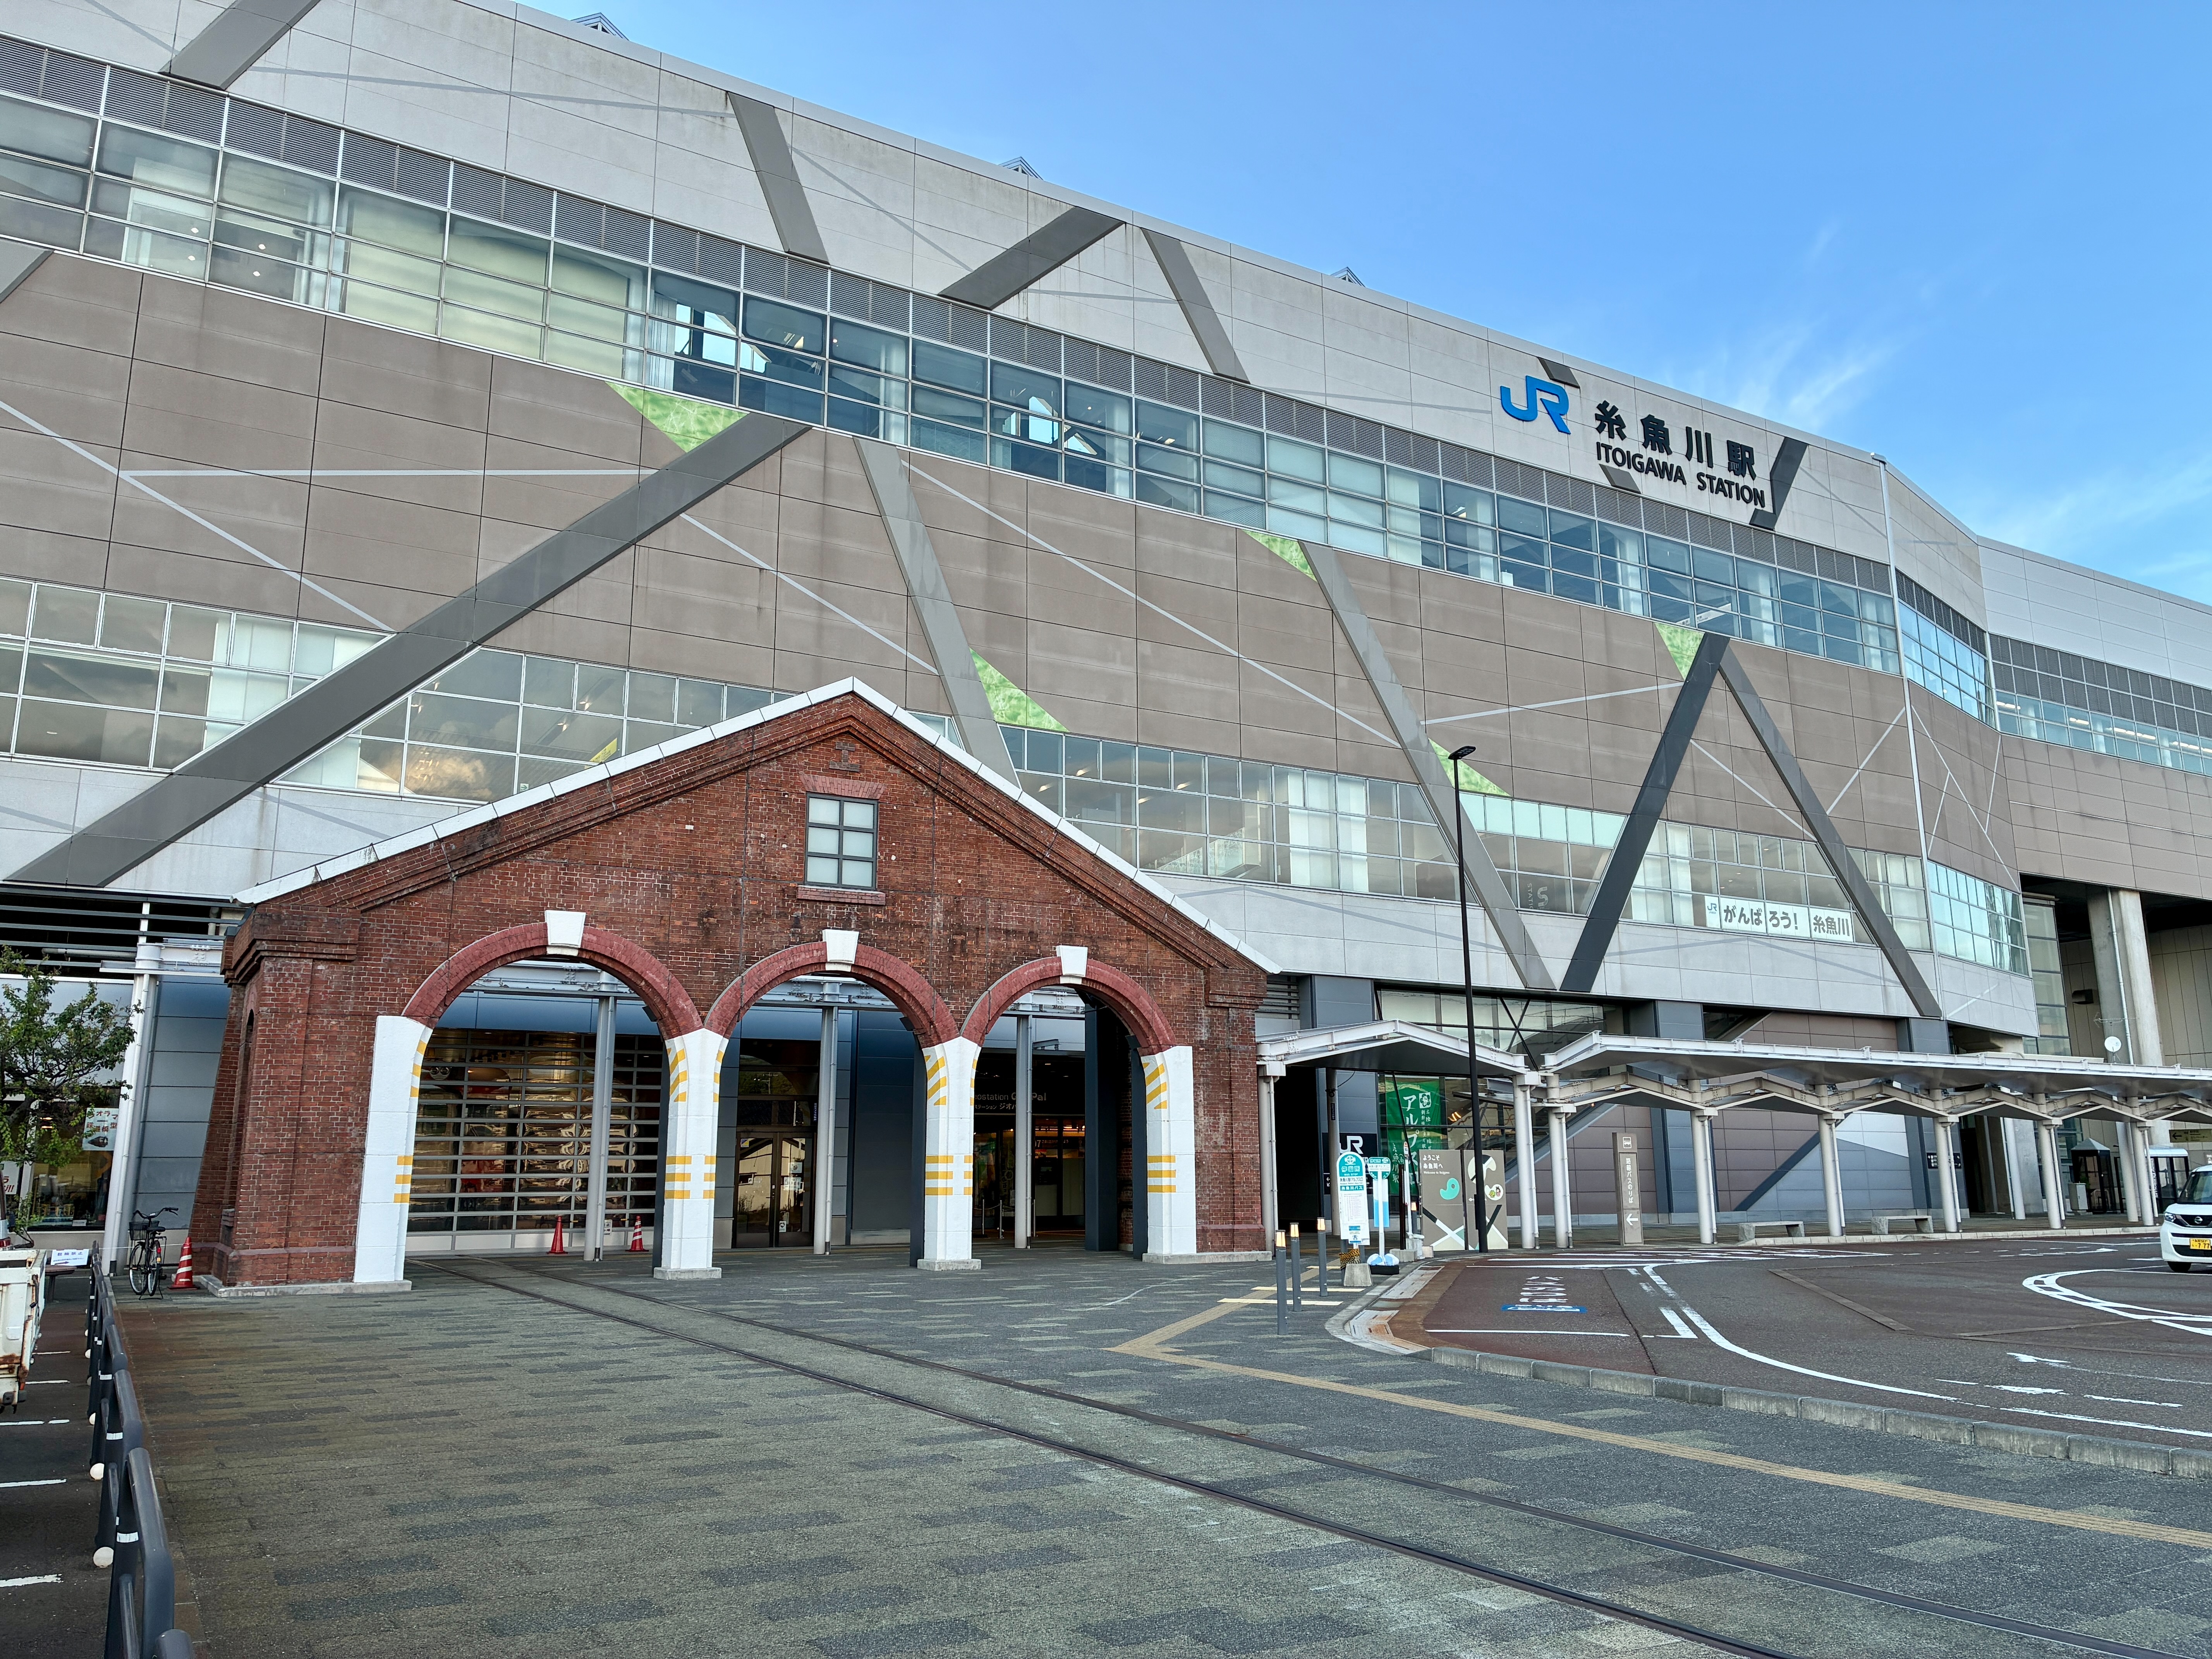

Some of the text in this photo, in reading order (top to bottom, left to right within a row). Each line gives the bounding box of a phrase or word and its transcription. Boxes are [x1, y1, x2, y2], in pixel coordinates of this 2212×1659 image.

[1500, 375, 1571, 434] JR
[1595, 400, 1757, 481] 糸魚川駅
[1596, 441, 1765, 508] ITOIGAWA STATION
[1707, 903, 1717, 911] JR
[1813, 915, 1850, 937] 糸魚川
[1625, 1158, 1633, 1203] 路線バスのりば
